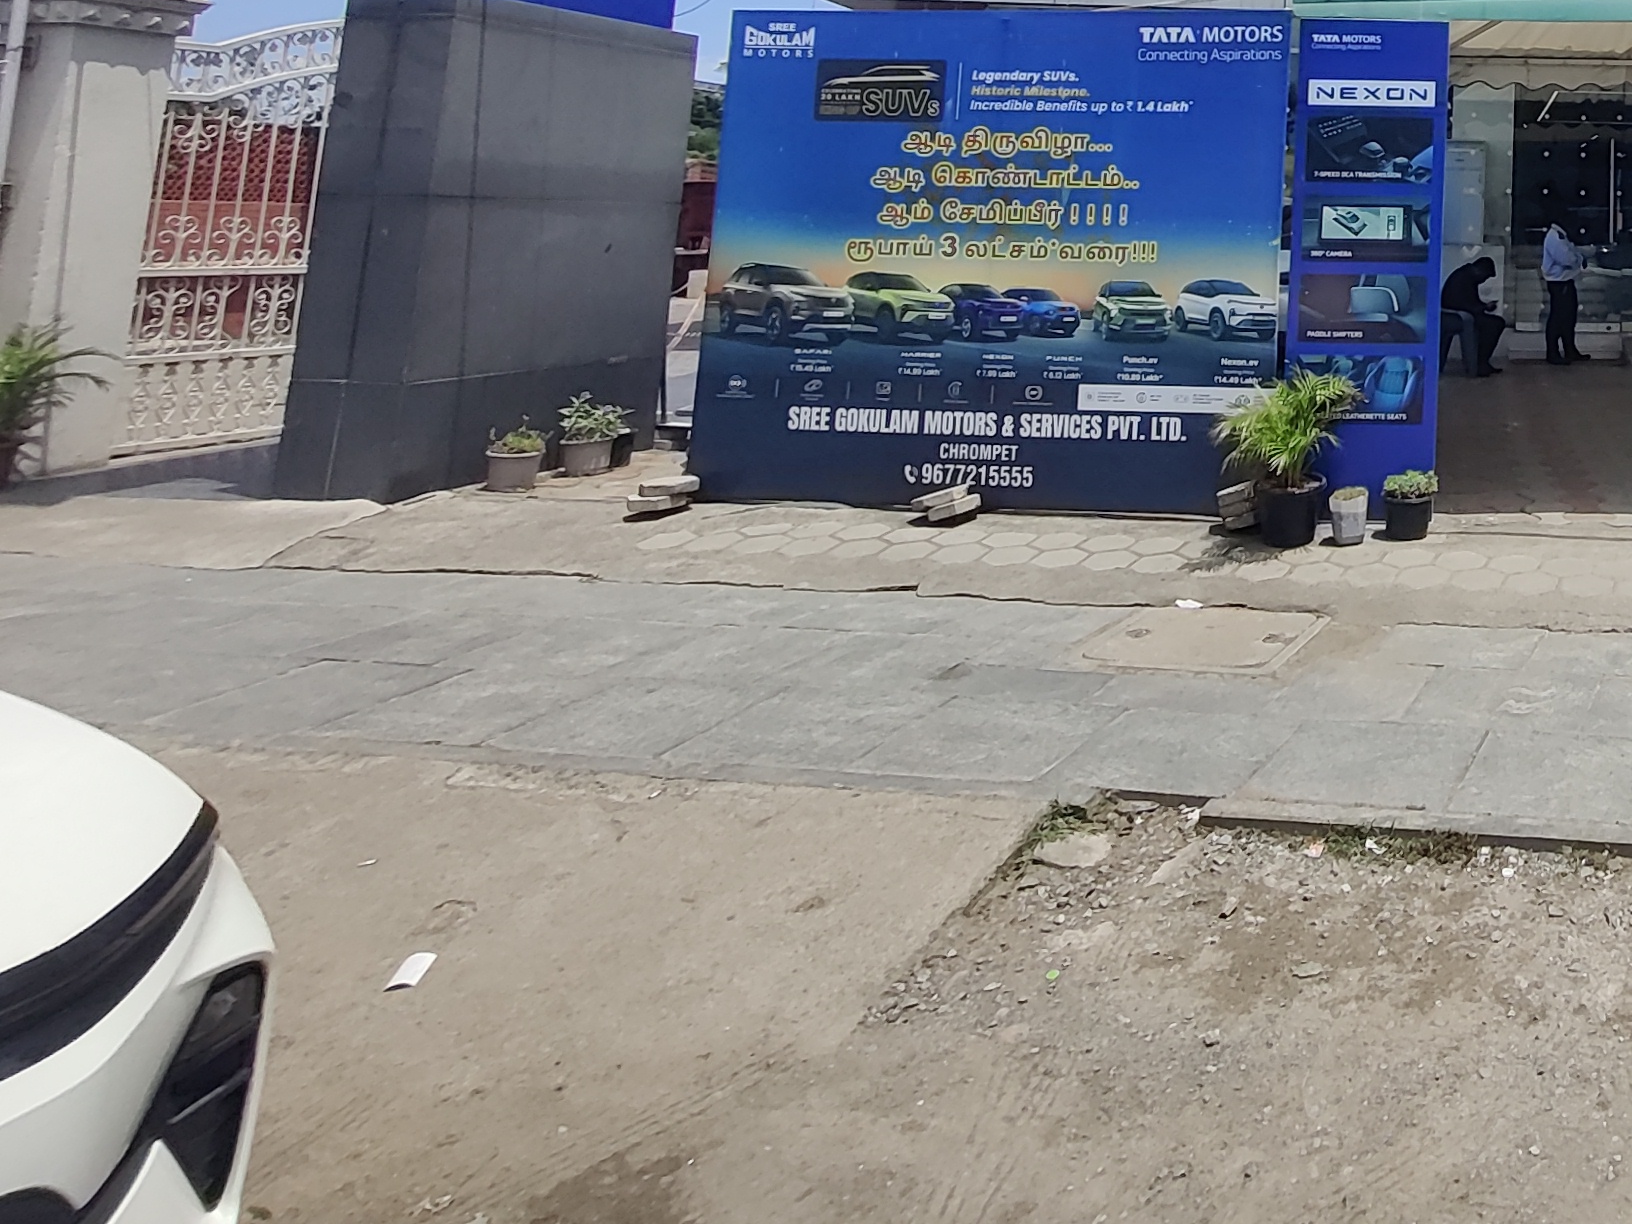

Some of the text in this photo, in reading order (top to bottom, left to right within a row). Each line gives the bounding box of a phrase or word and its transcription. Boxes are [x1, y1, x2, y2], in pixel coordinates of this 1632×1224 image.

[744, 25, 816, 46] GOKULAM
[768, 22, 797, 32] SREE
[1139, 25, 1284, 43] TATA MOTORS
[1311, 33, 1382, 44] TATA MOTORS
[743, 48, 814, 58] MOTORS
[1137, 48, 1283, 64] Connecting Aspirations
[971, 70, 1080, 85] Legendary SUVs.
[971, 85, 1091, 98] Historic Milestone.
[1316, 86, 1428, 102] NEXON
[862, 88, 940, 117] SUVs
[970, 99, 1034, 112] Incredible
[1036, 99, 1088, 112] Benefits
[1090, 103, 1108, 115] up
[1110, 101, 1124, 112] to
[902, 129, 956, 156] ஆடி
[870, 166, 925, 193] ஆடி
[878, 199, 934, 228] ஆம்
[845, 232, 959, 263] ரூபாய் 3
[787, 405, 1188, 443] SREE GOKULAM MOTORS & SERVICES PVT. LTD.
[938, 442, 1020, 462] CHROMPET
[920, 463, 1035, 489] 9677215555
